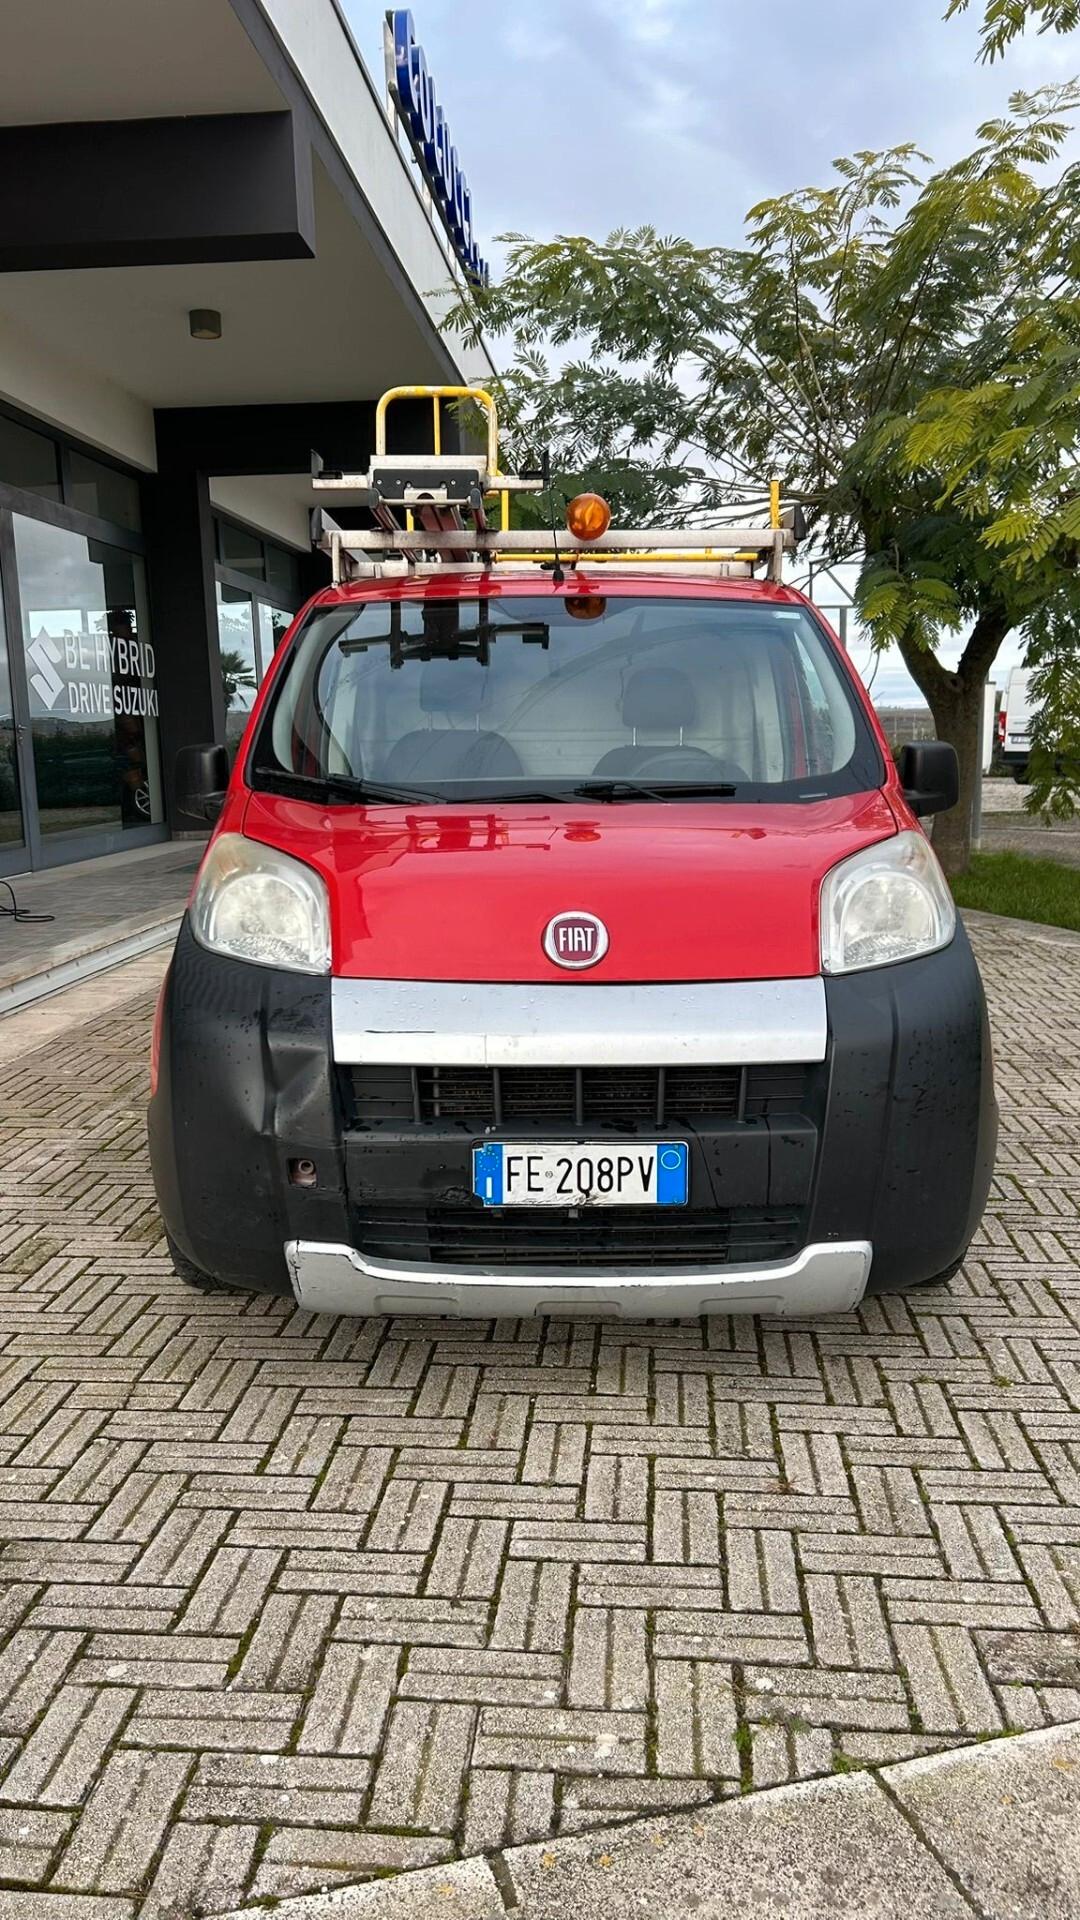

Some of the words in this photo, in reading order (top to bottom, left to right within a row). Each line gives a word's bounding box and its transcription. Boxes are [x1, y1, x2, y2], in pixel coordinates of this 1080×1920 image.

[64, 629, 91, 671] BE
[95, 633, 156, 679] HYBRID
[68, 682, 113, 714] DRIVE
[113, 685, 159, 717] SUZUKI
[558, 927, 595, 952] FIAT
[506, 1156, 544, 1192] FE
